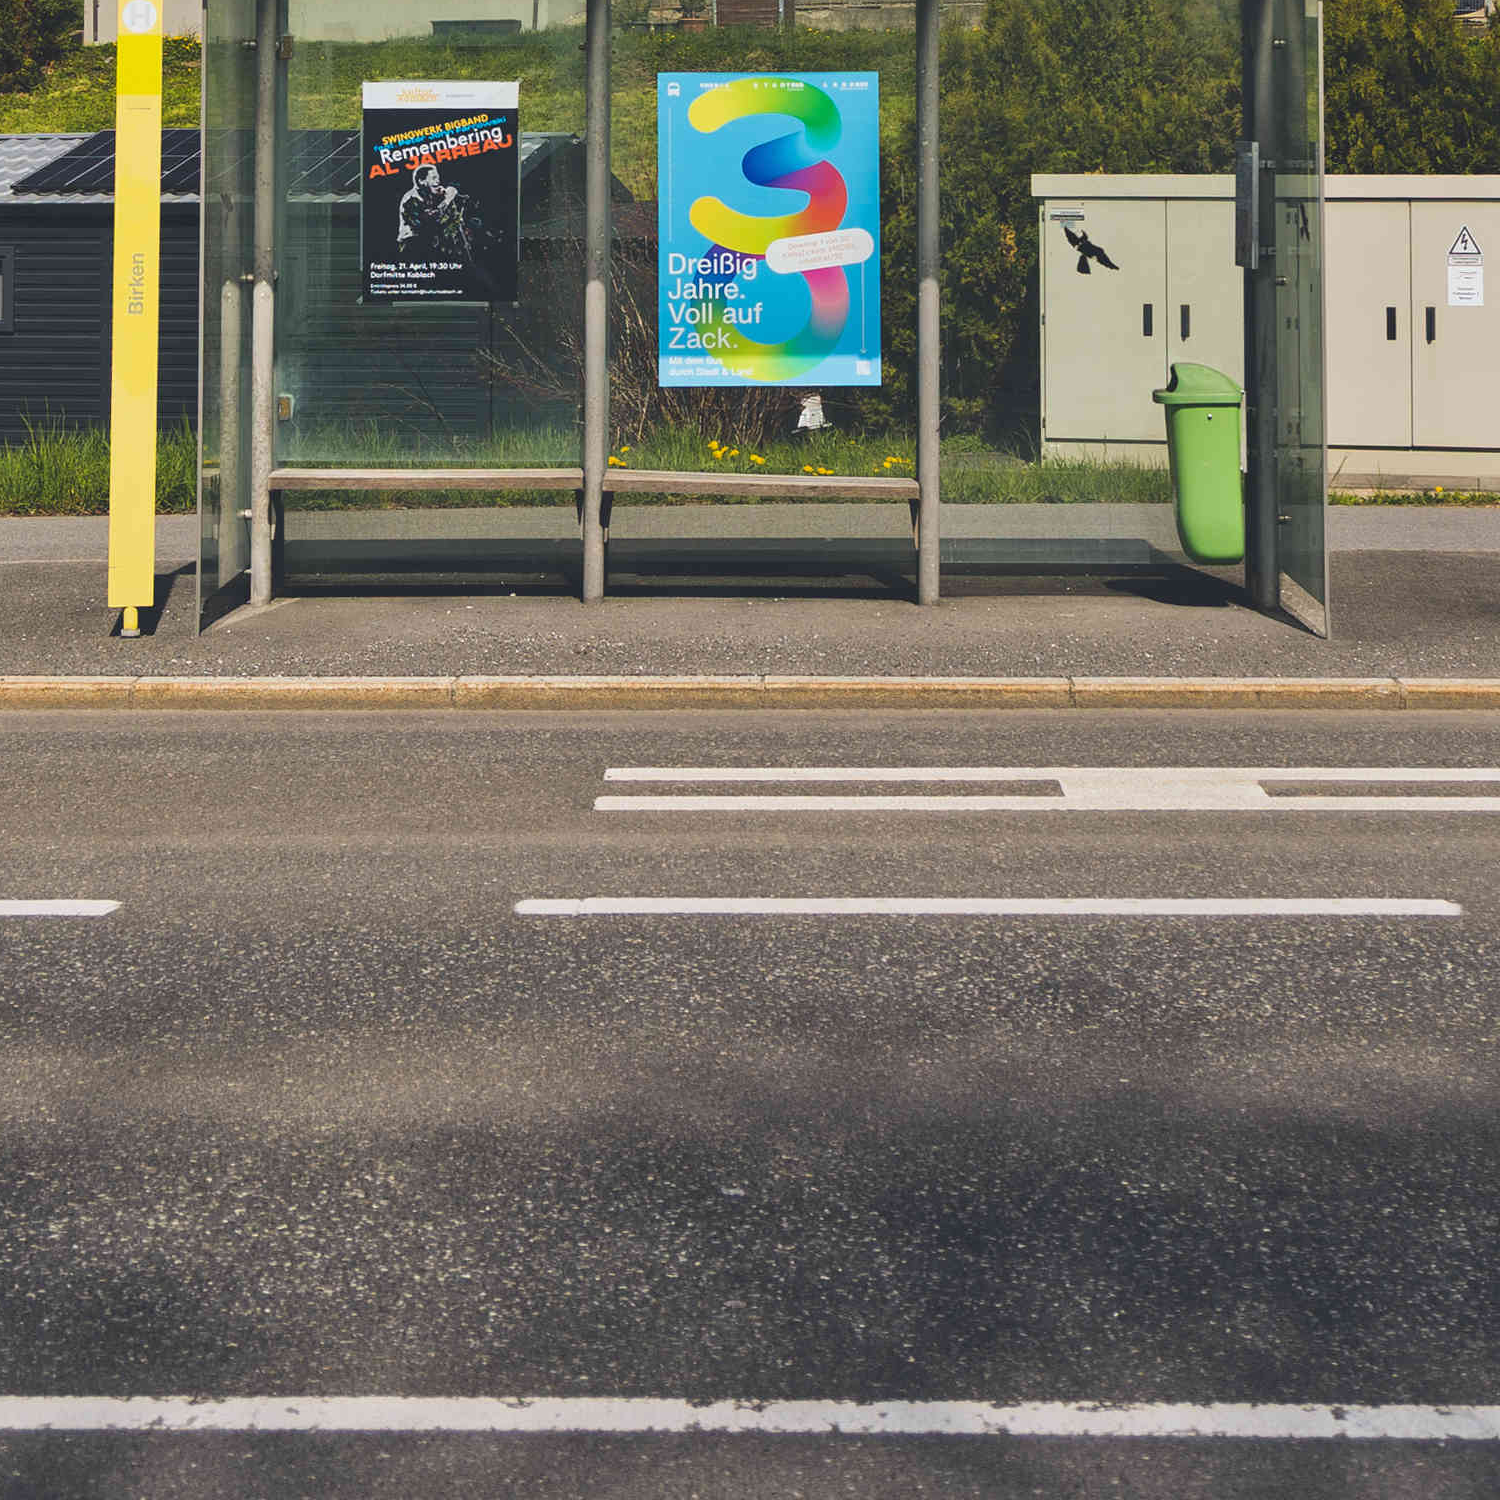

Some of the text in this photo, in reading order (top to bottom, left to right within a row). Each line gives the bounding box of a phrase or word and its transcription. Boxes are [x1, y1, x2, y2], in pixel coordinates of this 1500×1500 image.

[381, 113, 489, 146] SWINGWERK BIGBAND
[368, 133, 514, 180] AL JARREAU
[379, 126, 503, 165] Remembering
[668, 252, 757, 280] Dreißig
[128, 253, 145, 315] Birken
[667, 277, 746, 300] Jahre.
[667, 302, 764, 325] Voll auf
[668, 327, 739, 349] Zack.
